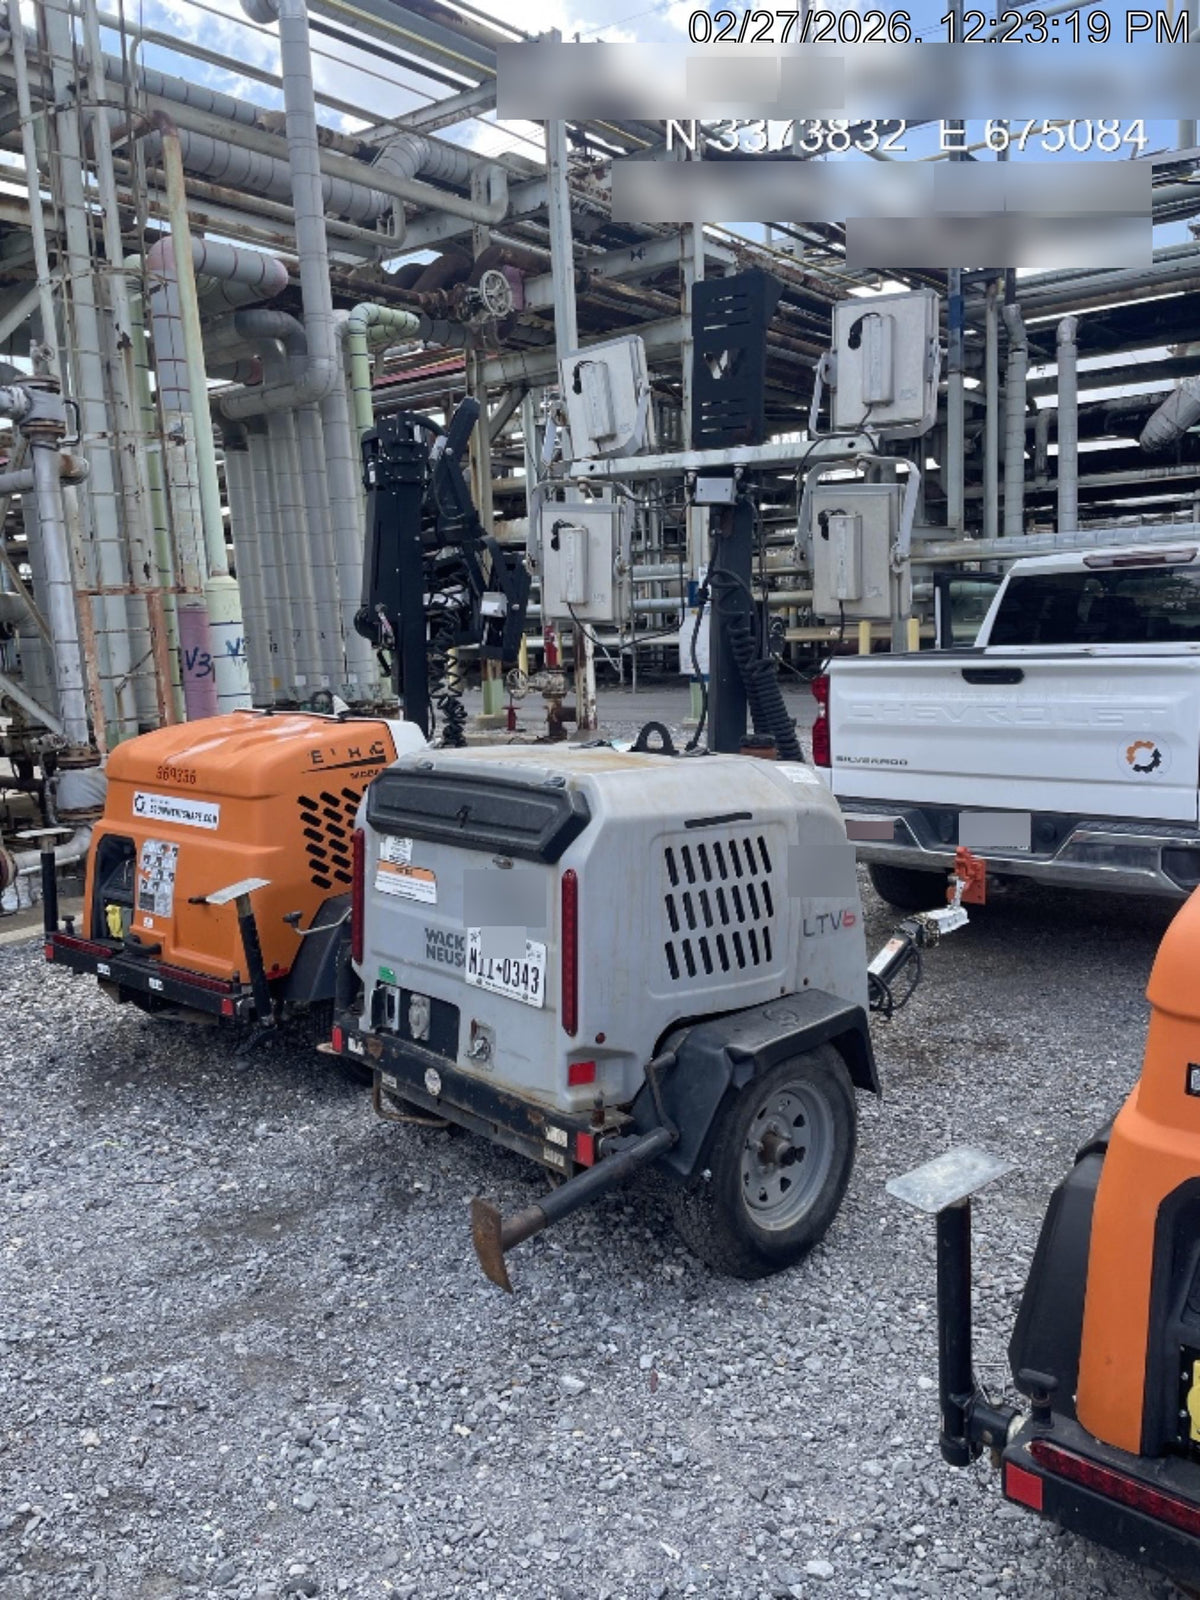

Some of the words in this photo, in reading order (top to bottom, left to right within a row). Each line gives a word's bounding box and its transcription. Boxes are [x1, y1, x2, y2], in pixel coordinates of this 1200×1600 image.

[185, 646, 212, 678] V3
[845, 703, 1168, 728] CHEVROLET
[835, 755, 909, 766] SILVERADO
[803, 909, 857, 938] LTV6
[424, 927, 465, 951] WACK
[425, 943, 466, 968] NEUS
